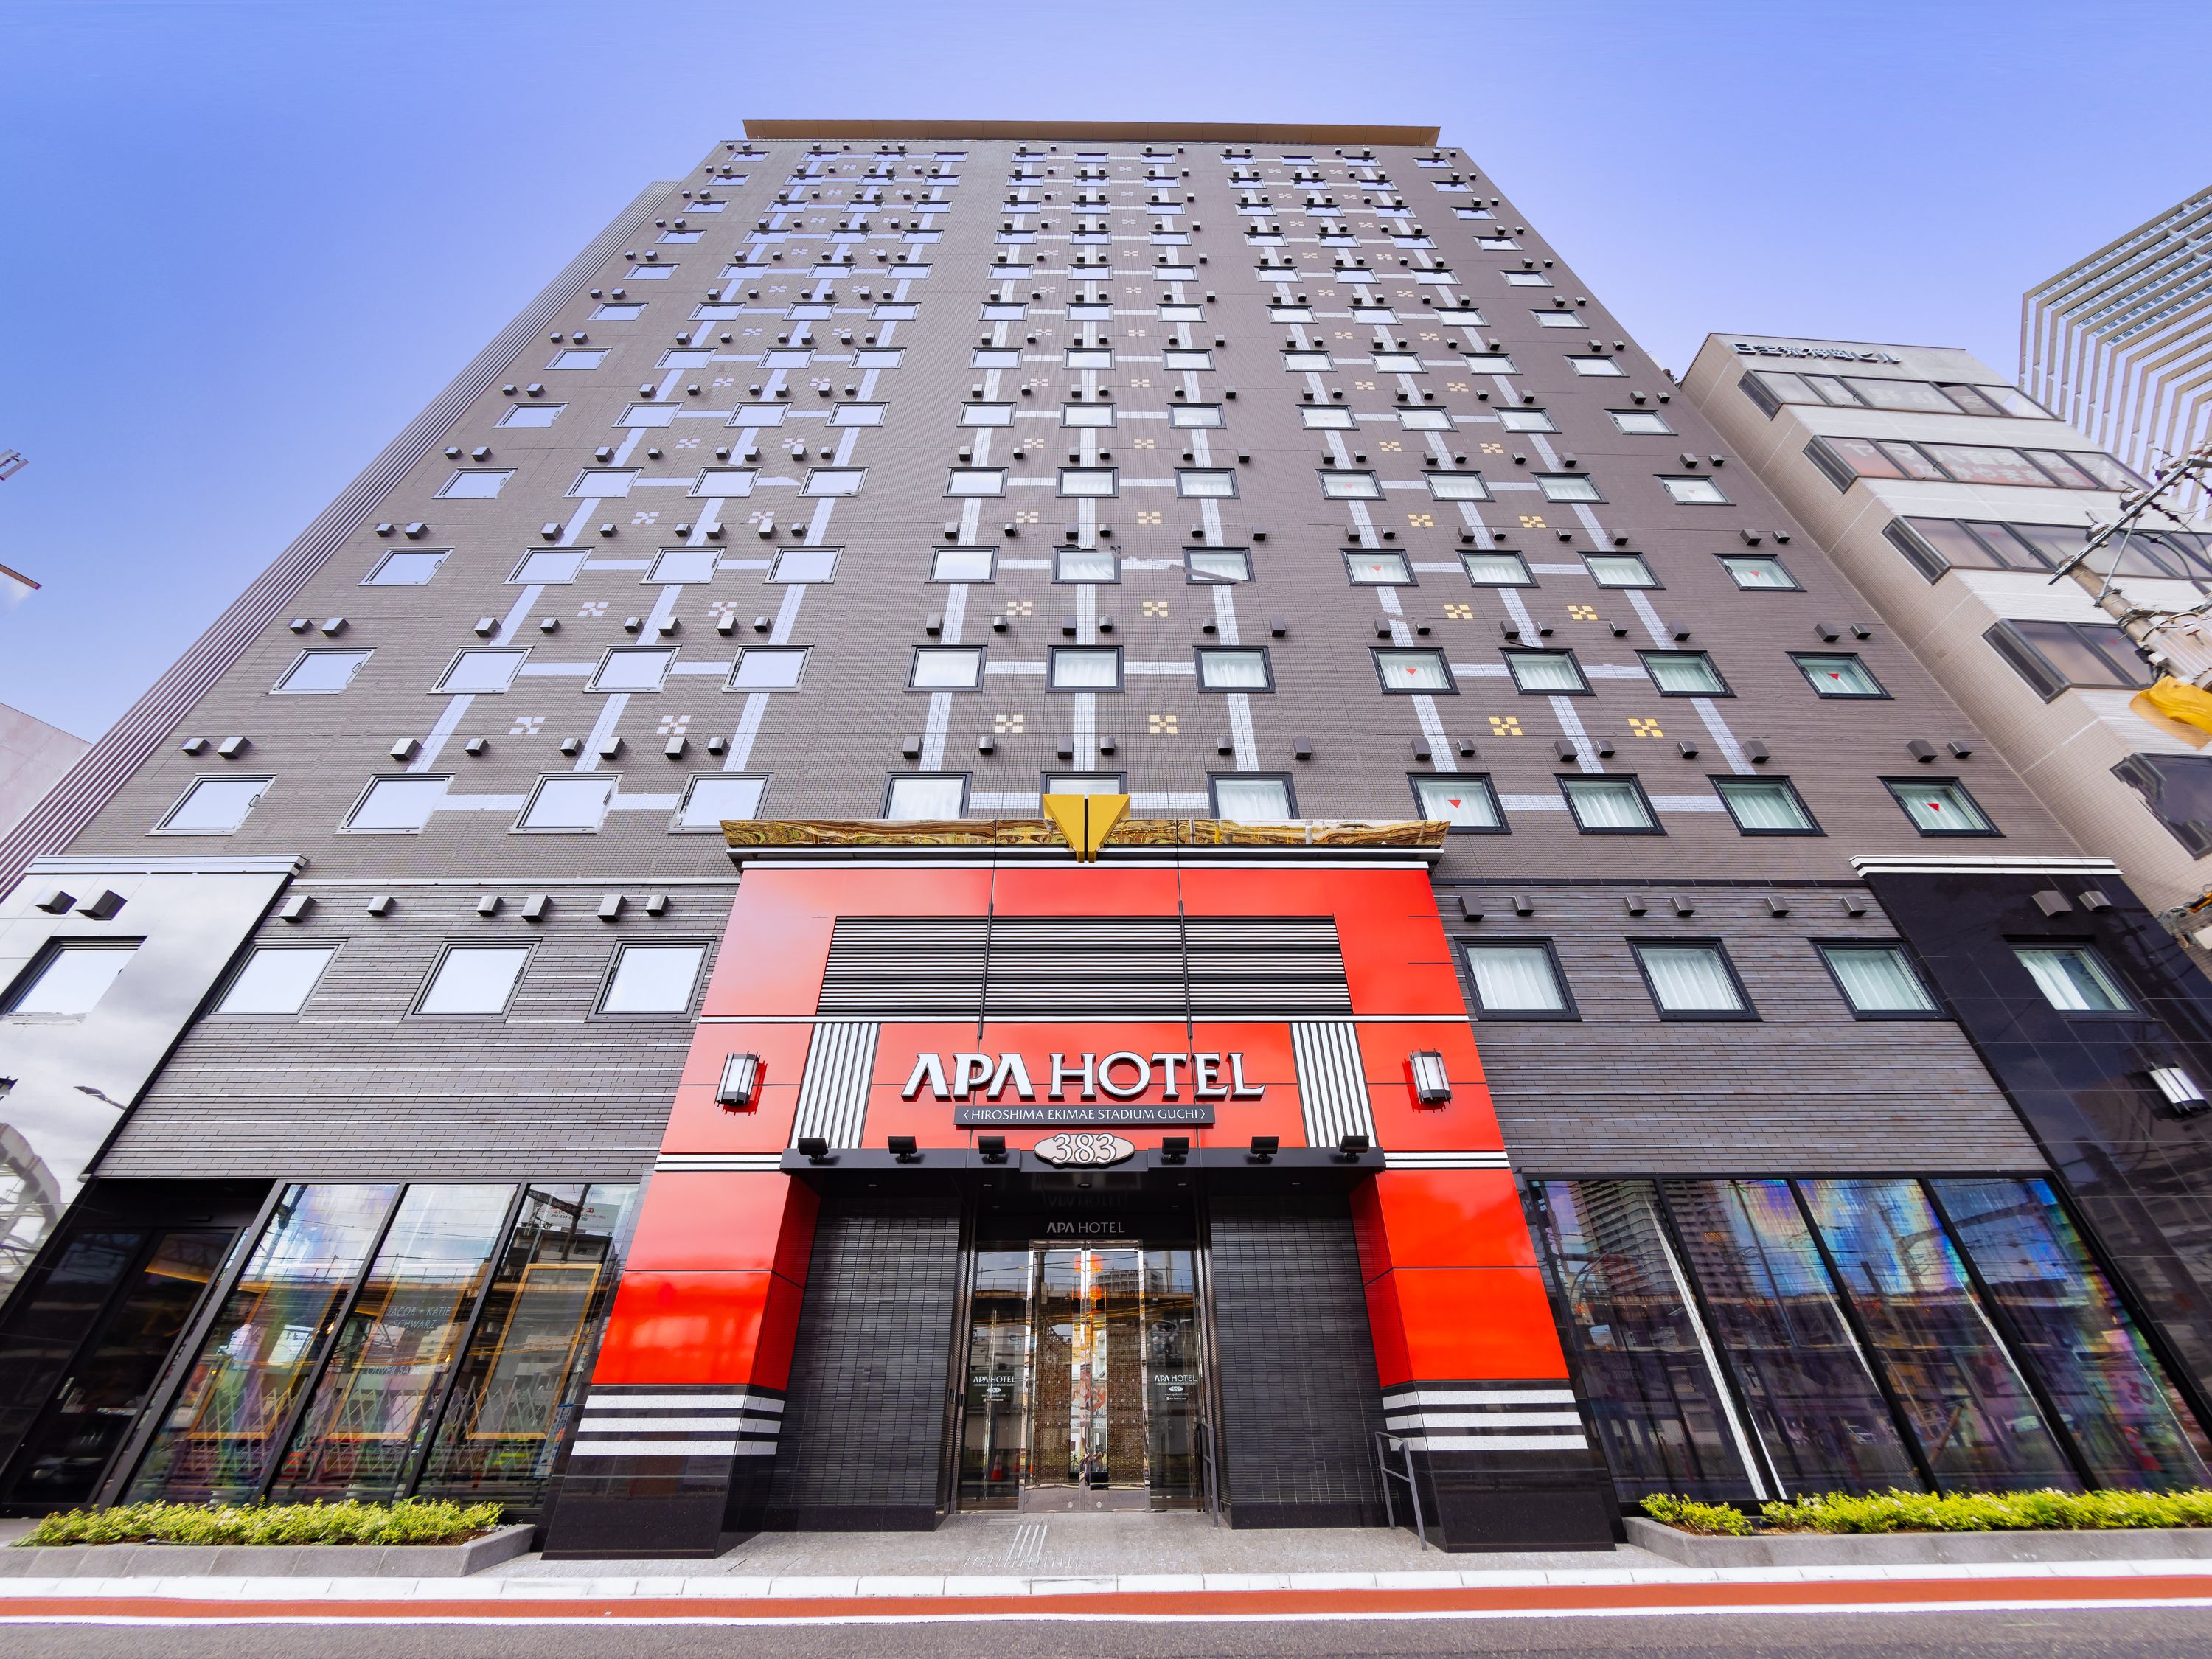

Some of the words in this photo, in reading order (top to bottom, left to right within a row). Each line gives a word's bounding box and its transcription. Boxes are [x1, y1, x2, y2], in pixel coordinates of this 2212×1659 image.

[900, 1052, 1035, 1099] APA
[1048, 1051, 1266, 1099] HOTEL
[1048, 1109, 1095, 1119] EKIMAE
[1098, 1109, 1154, 1119] STADIUM
[1051, 1133, 1116, 1165] 383
[1047, 1222, 1074, 1233] APA
[1078, 1222, 1125, 1234] HOTEL
[386, 1306, 416, 1316] JACOB
[427, 1306, 452, 1316] KATIE
